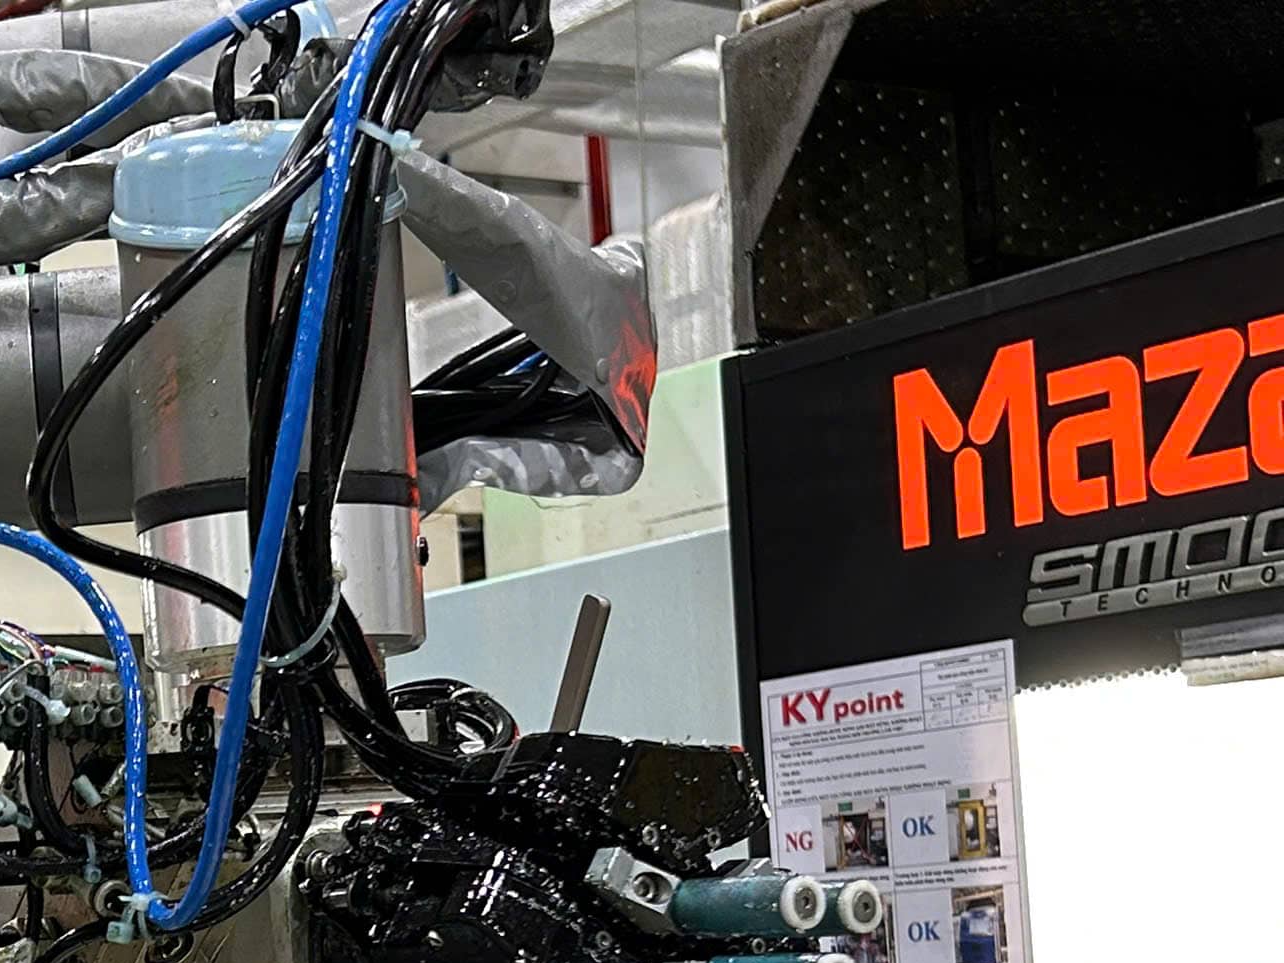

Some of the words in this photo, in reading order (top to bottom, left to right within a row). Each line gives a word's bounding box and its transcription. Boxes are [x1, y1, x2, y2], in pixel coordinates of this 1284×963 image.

[1059, 564, 1277, 618] TECHNO
[781, 687, 832, 727] KY
[833, 688, 904, 722] point
[902, 815, 935, 837] OK
[785, 831, 813, 852] NG
[907, 920, 941, 943] OK
